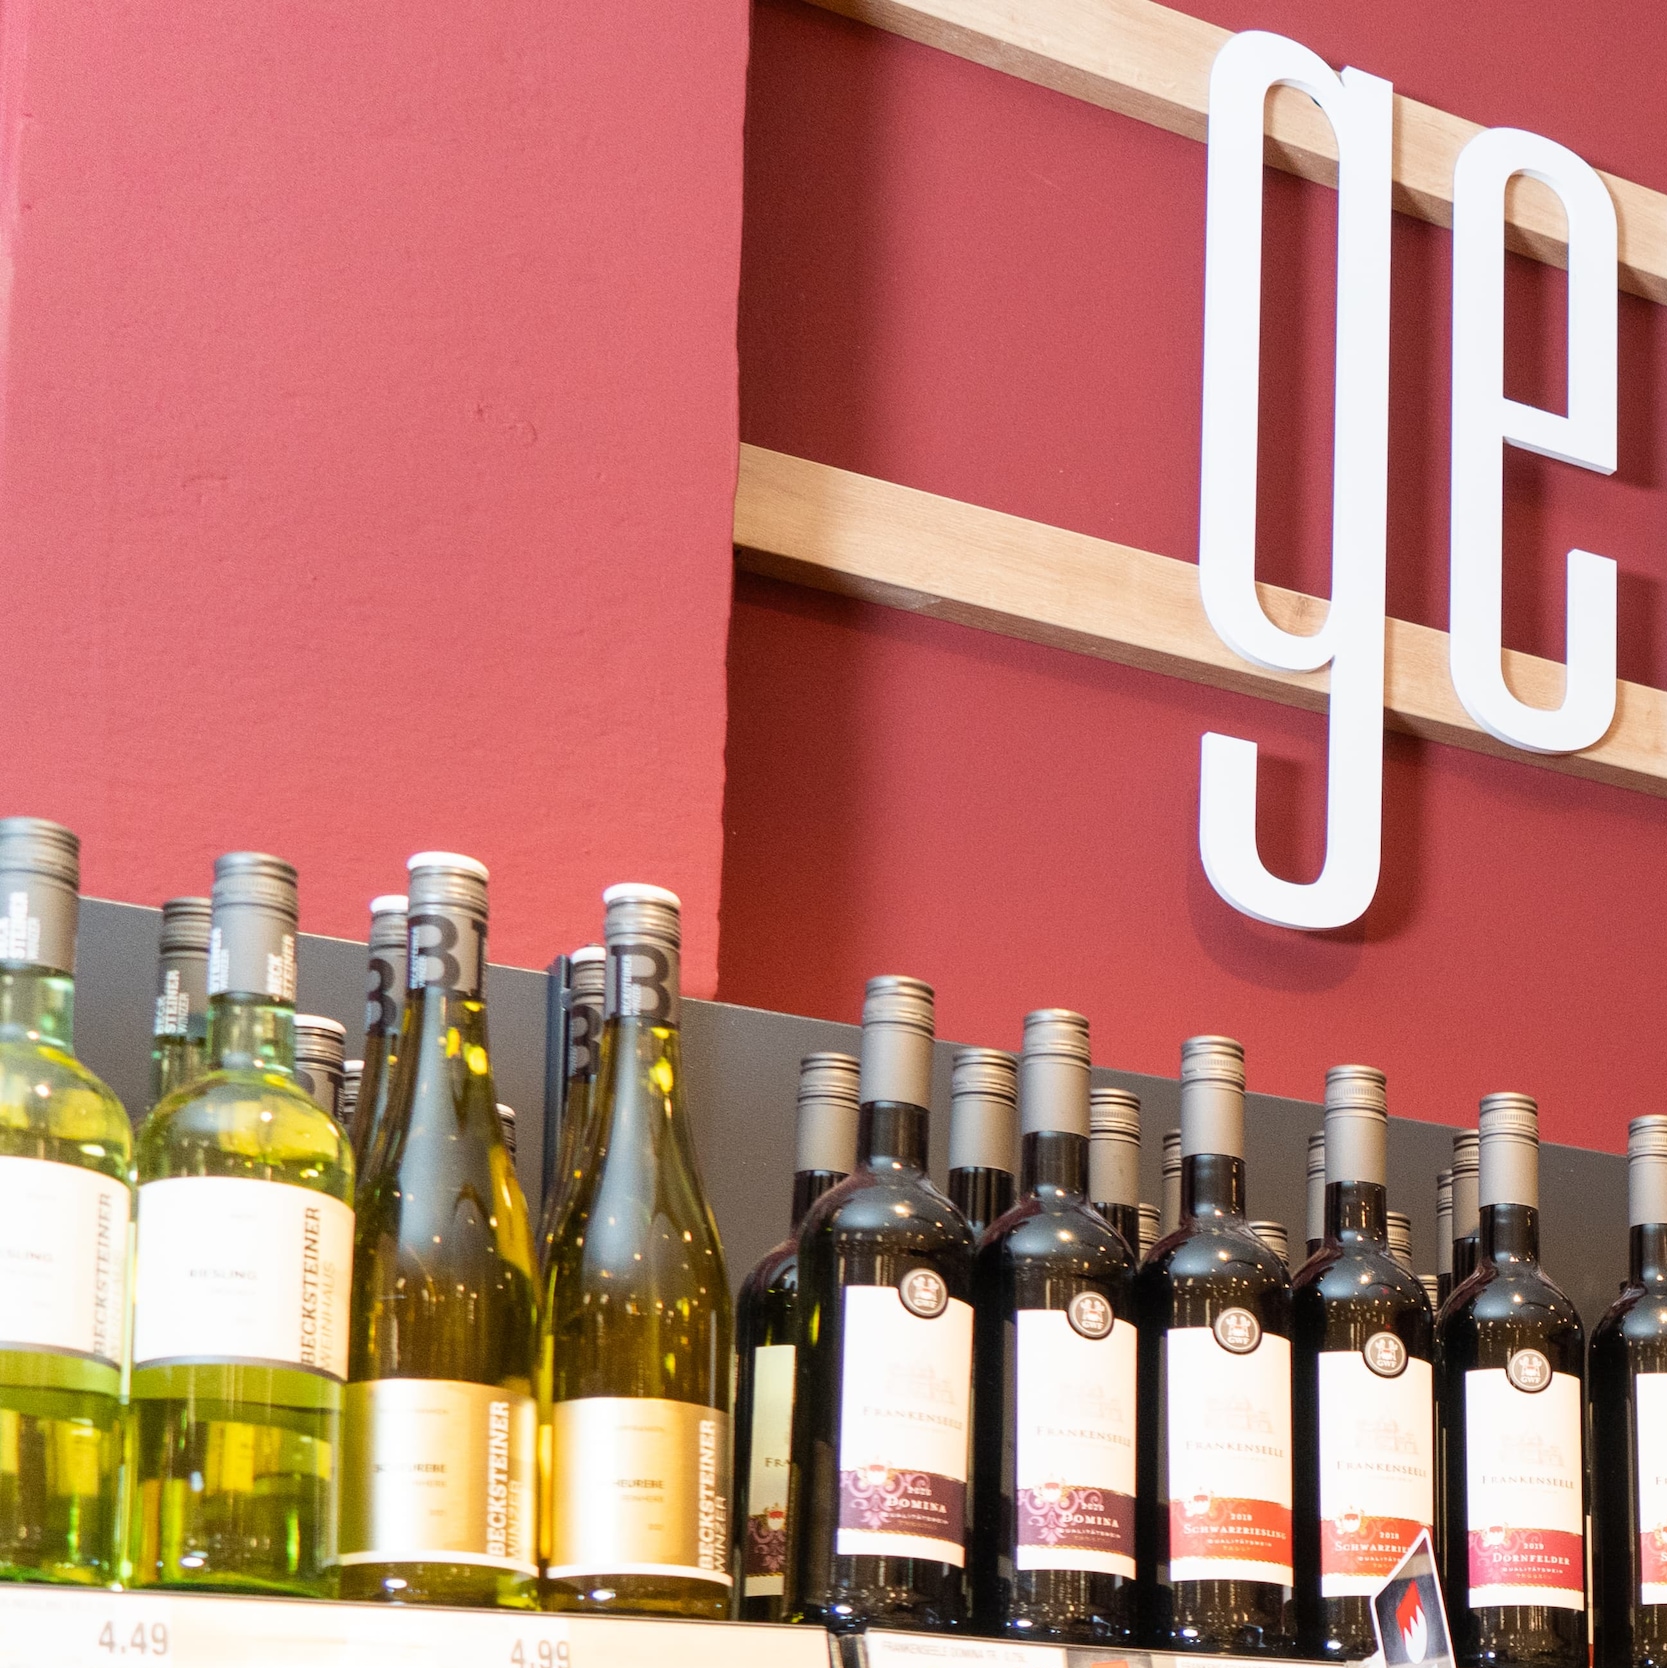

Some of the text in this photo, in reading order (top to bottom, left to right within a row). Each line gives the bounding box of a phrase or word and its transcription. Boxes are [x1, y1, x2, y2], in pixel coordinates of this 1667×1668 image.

[302, 1206, 321, 1366] BECKSTEINER
[1185, 1440, 1284, 1458] FRANKENSEELE
[1336, 1460, 1427, 1479] FRANKENSEELE
[487, 1401, 508, 1558] BECKSTEINER
[1482, 1475, 1574, 1490] FRANKENSEELE
[698, 1420, 716, 1570] BECKSTEINER
[886, 1498, 947, 1513] DOMINA
[1061, 1513, 1119, 1528] DOMINA
[1183, 1523, 1286, 1540] SCHWARZRIESLING
[1492, 1552, 1570, 1565] DORNFELDER
[99, 1622, 170, 1656] 4.49
